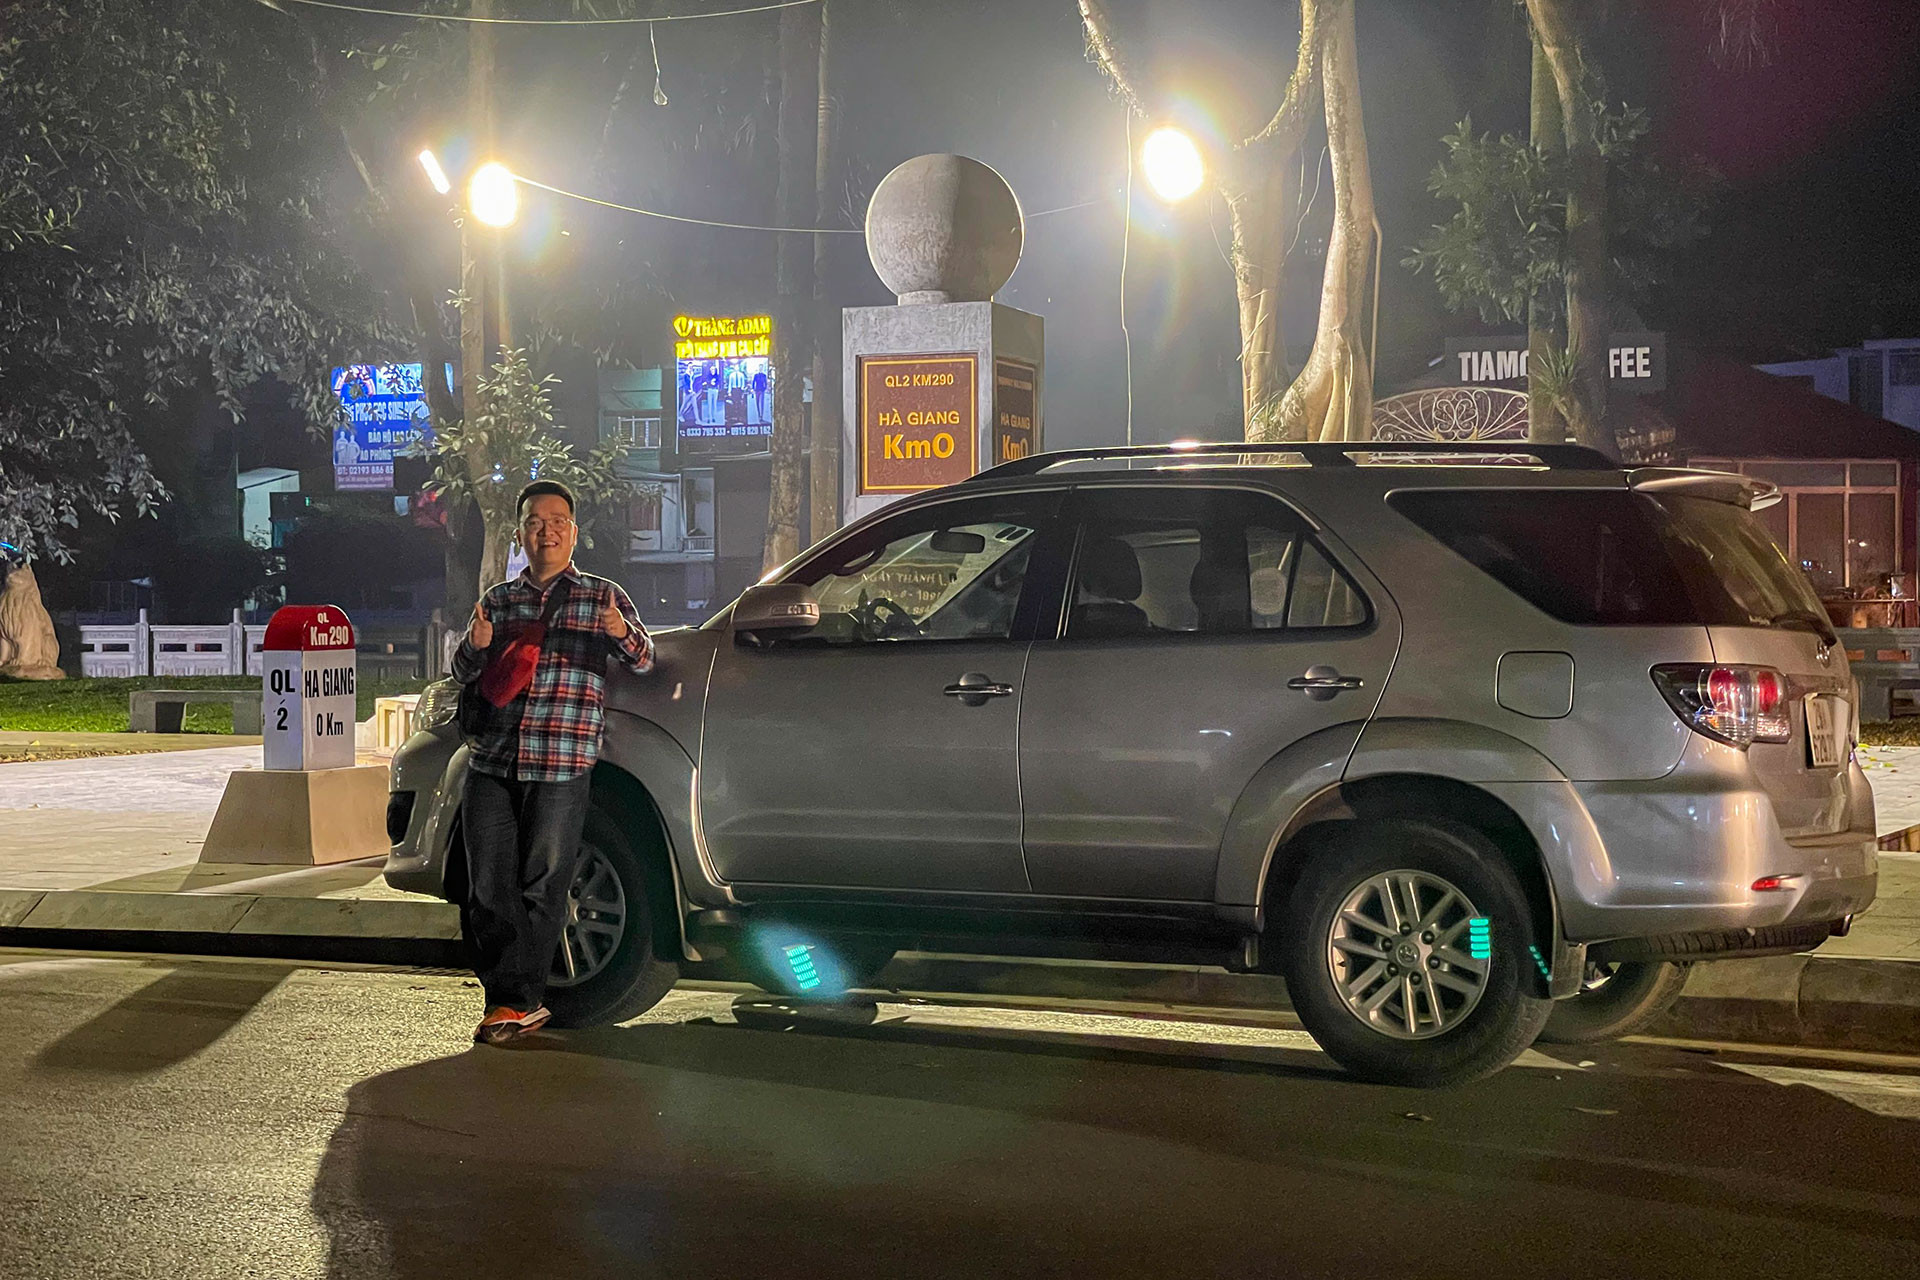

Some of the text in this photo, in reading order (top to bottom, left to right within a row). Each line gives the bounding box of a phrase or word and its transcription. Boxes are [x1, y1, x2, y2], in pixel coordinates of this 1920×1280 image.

[736, 317, 770, 335] ADAM
[1609, 347, 1650, 378] FEE
[885, 374, 954, 388] QL2 KM290
[879, 408, 960, 426] HÀ GIANG
[1010, 414, 1030, 430] GIANG
[317, 612, 329, 624] QL
[270, 669, 295, 696] QL
[322, 667, 354, 697] GIANG
[316, 713, 344, 736] 0 Km
